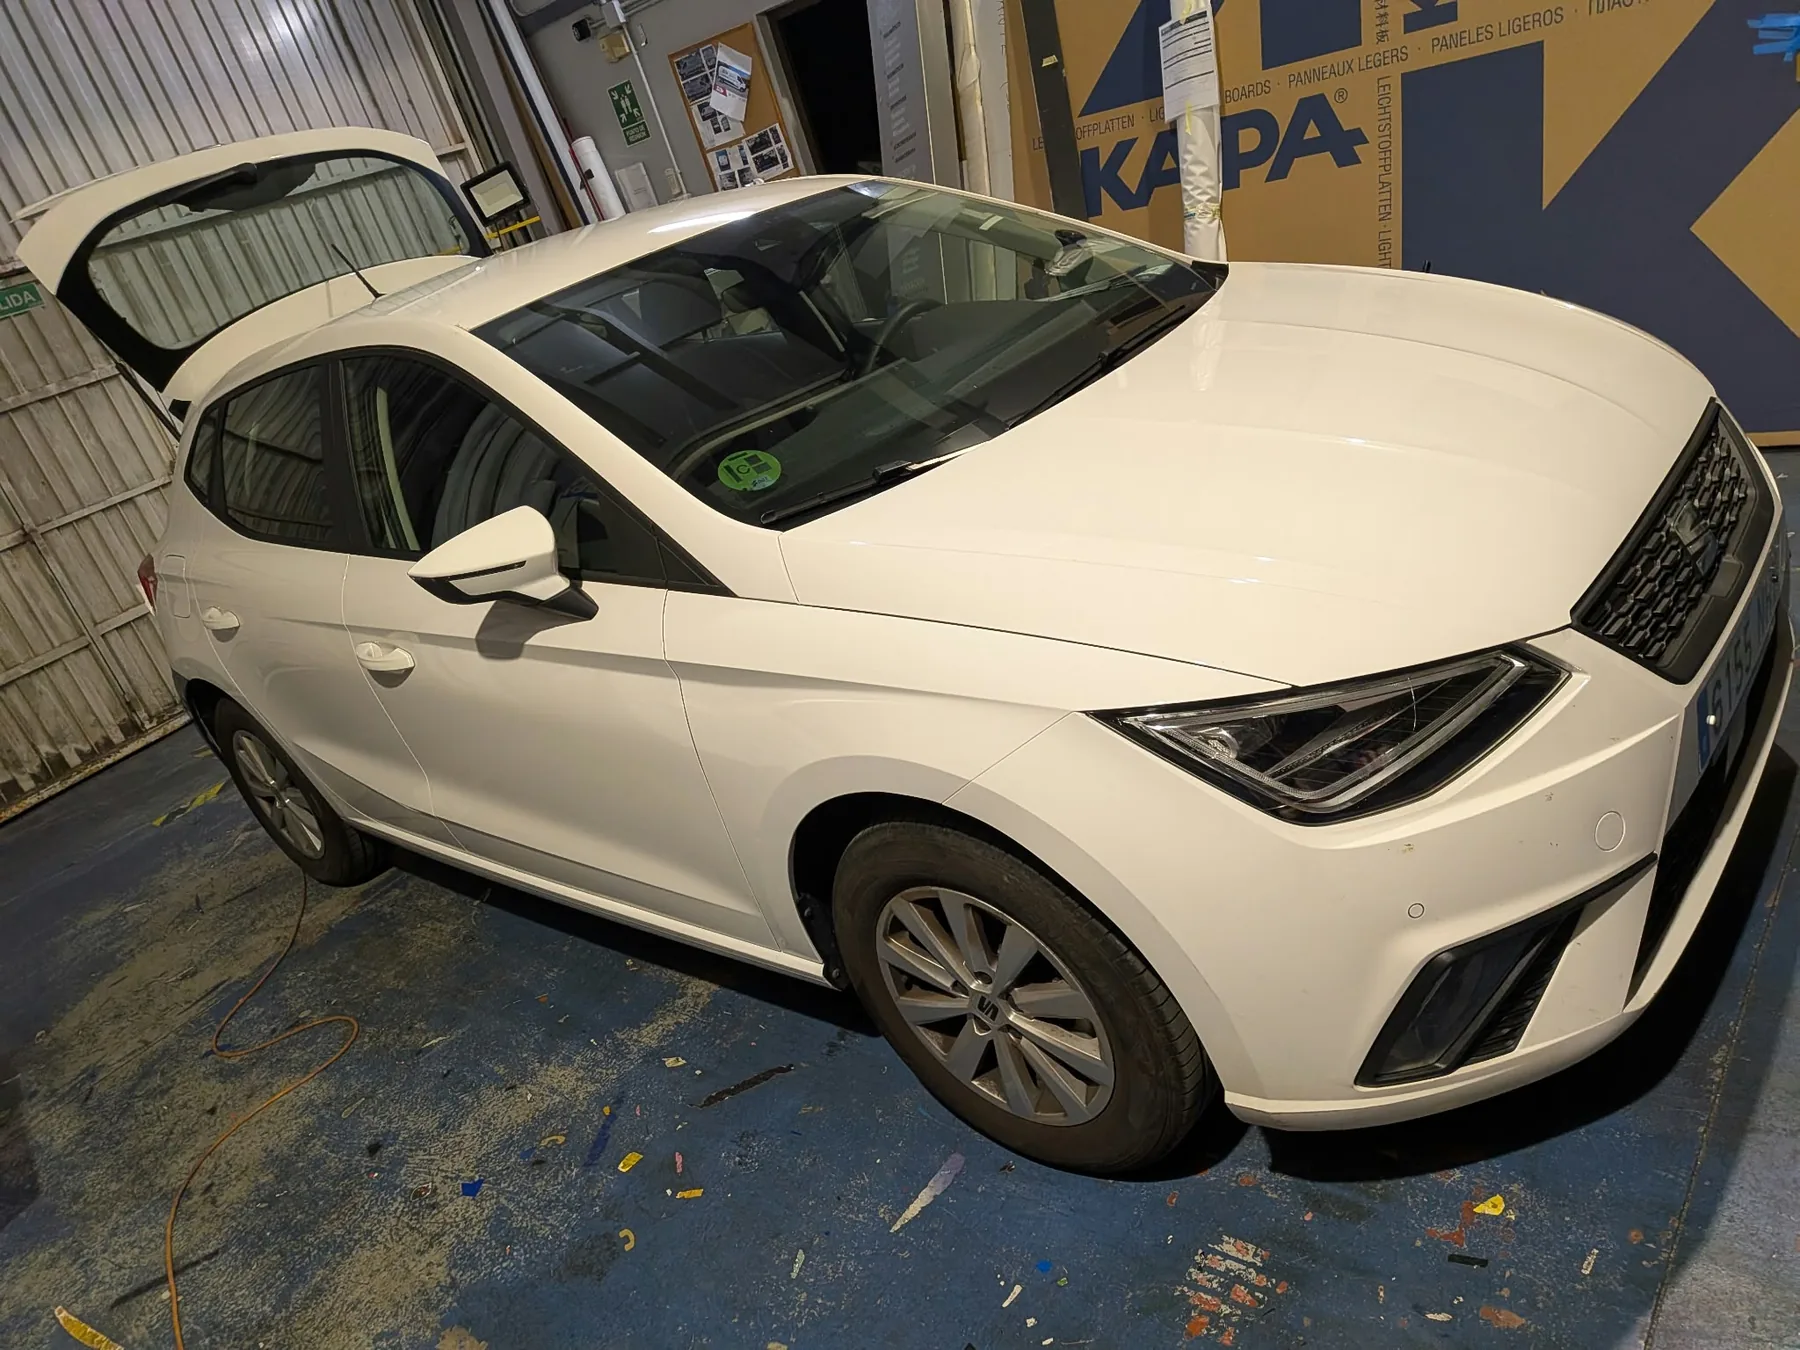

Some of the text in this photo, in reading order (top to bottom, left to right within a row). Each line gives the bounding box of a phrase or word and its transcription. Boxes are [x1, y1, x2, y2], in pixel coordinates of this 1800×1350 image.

[1224, 80, 1271, 104] BOARDS
[1288, 58, 1354, 89] PANNEAUX
[1358, 46, 1409, 72] LEGERS
[1431, 24, 1494, 54] PANELES
[1498, 6, 1564, 38] LIGEROS
[1377, 75, 1393, 222] LEICHTSTOFFPLATTEN
